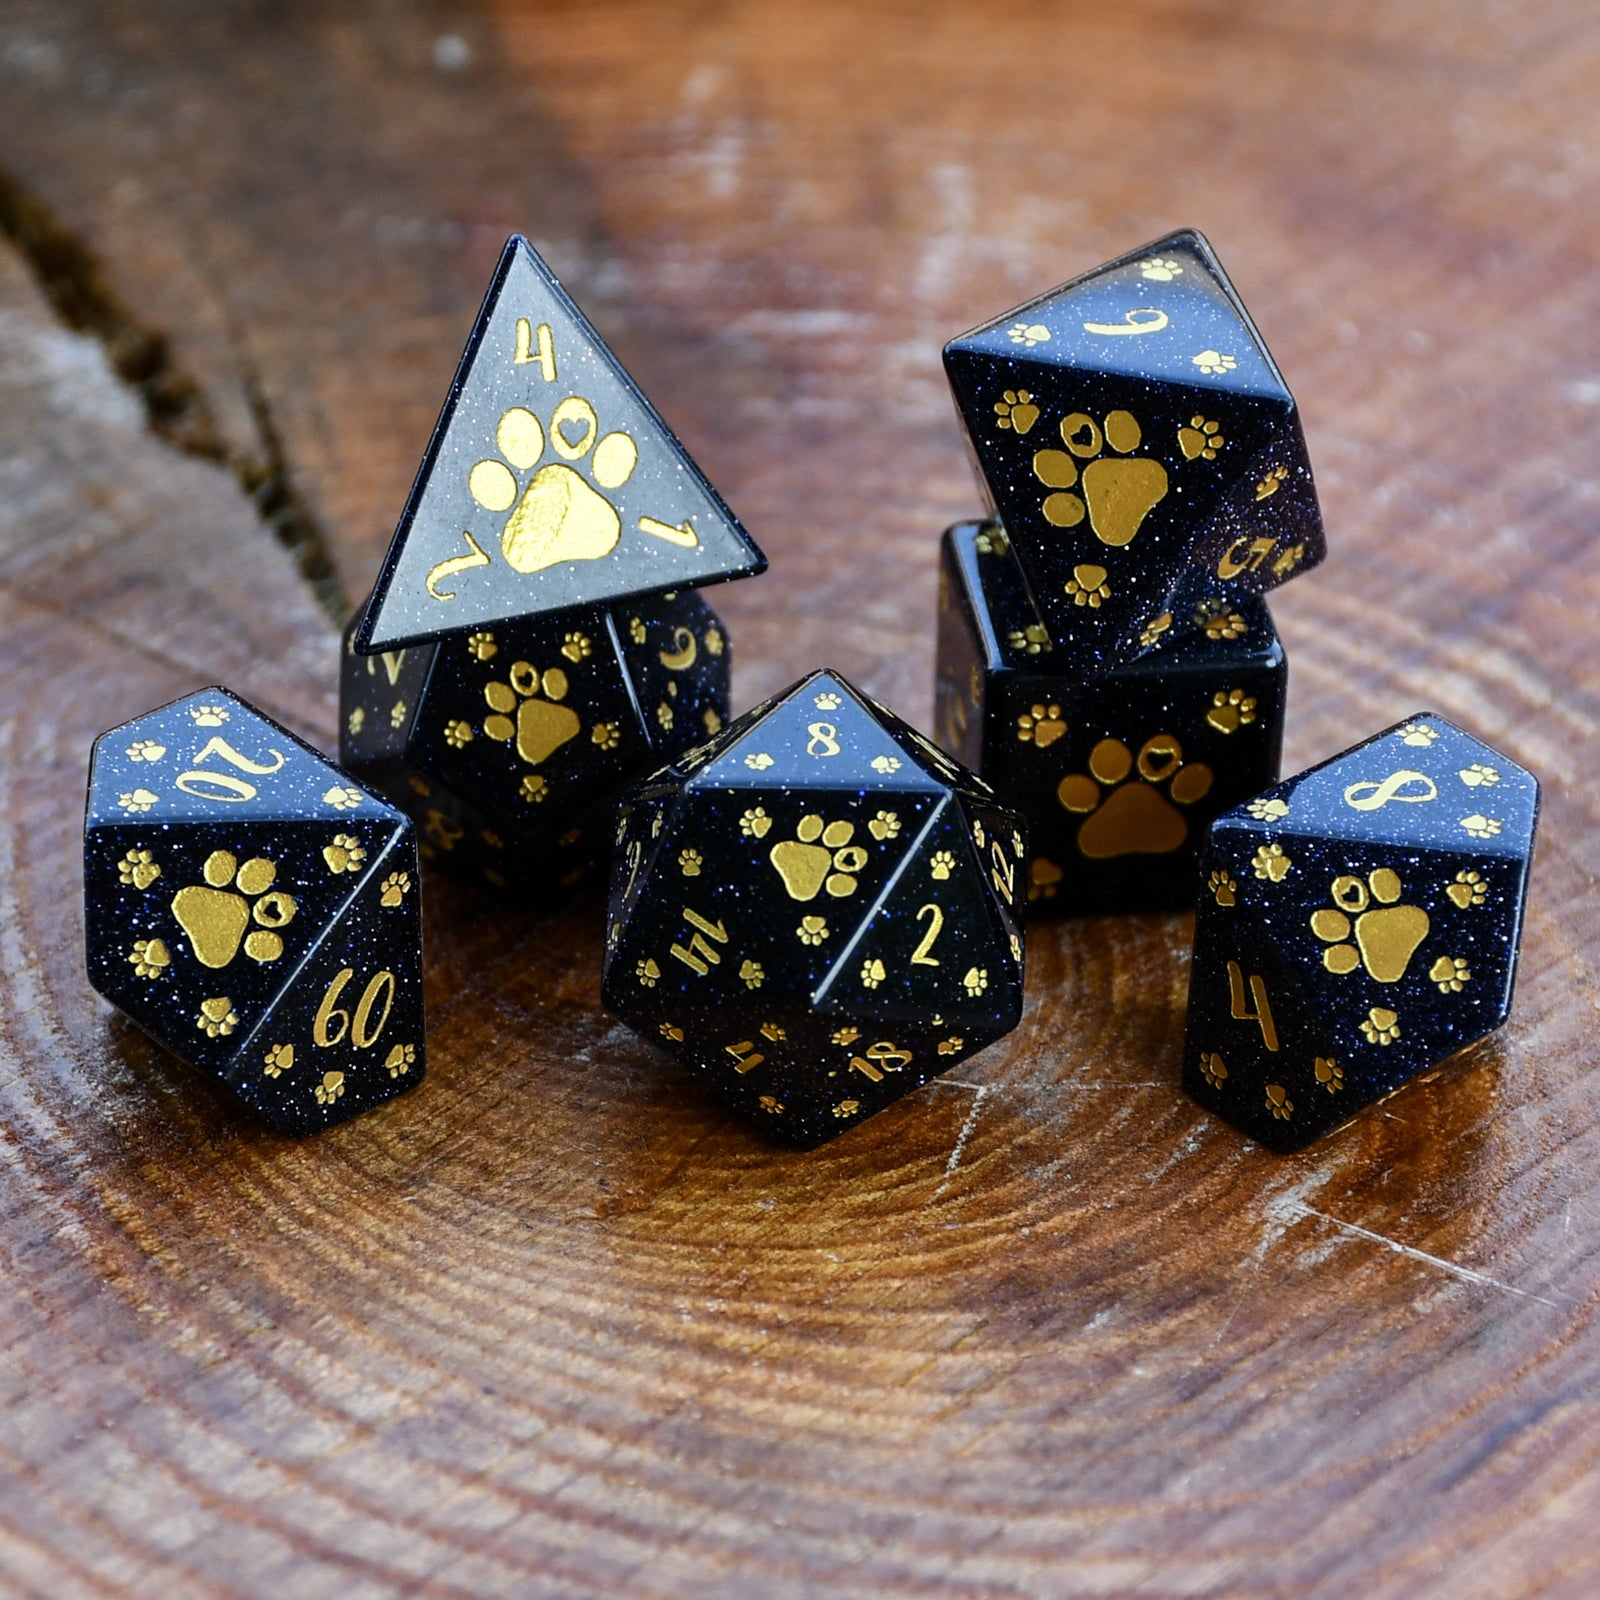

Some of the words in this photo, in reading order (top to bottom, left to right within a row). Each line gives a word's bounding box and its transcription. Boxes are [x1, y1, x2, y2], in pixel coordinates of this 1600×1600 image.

[514, 317, 558, 383] 4
[638, 515, 699, 548] 1
[1217, 536, 1277, 580] 5
[425, 531, 491, 601] 2
[174, 736, 285, 802] 20
[806, 721, 841, 757] 8
[1343, 769, 1438, 812] 8
[670, 907, 729, 976] 14
[911, 903, 945, 967] 2
[313, 967, 396, 1049] 60
[1227, 960, 1280, 1053] 4
[848, 1040, 914, 1083] 18
